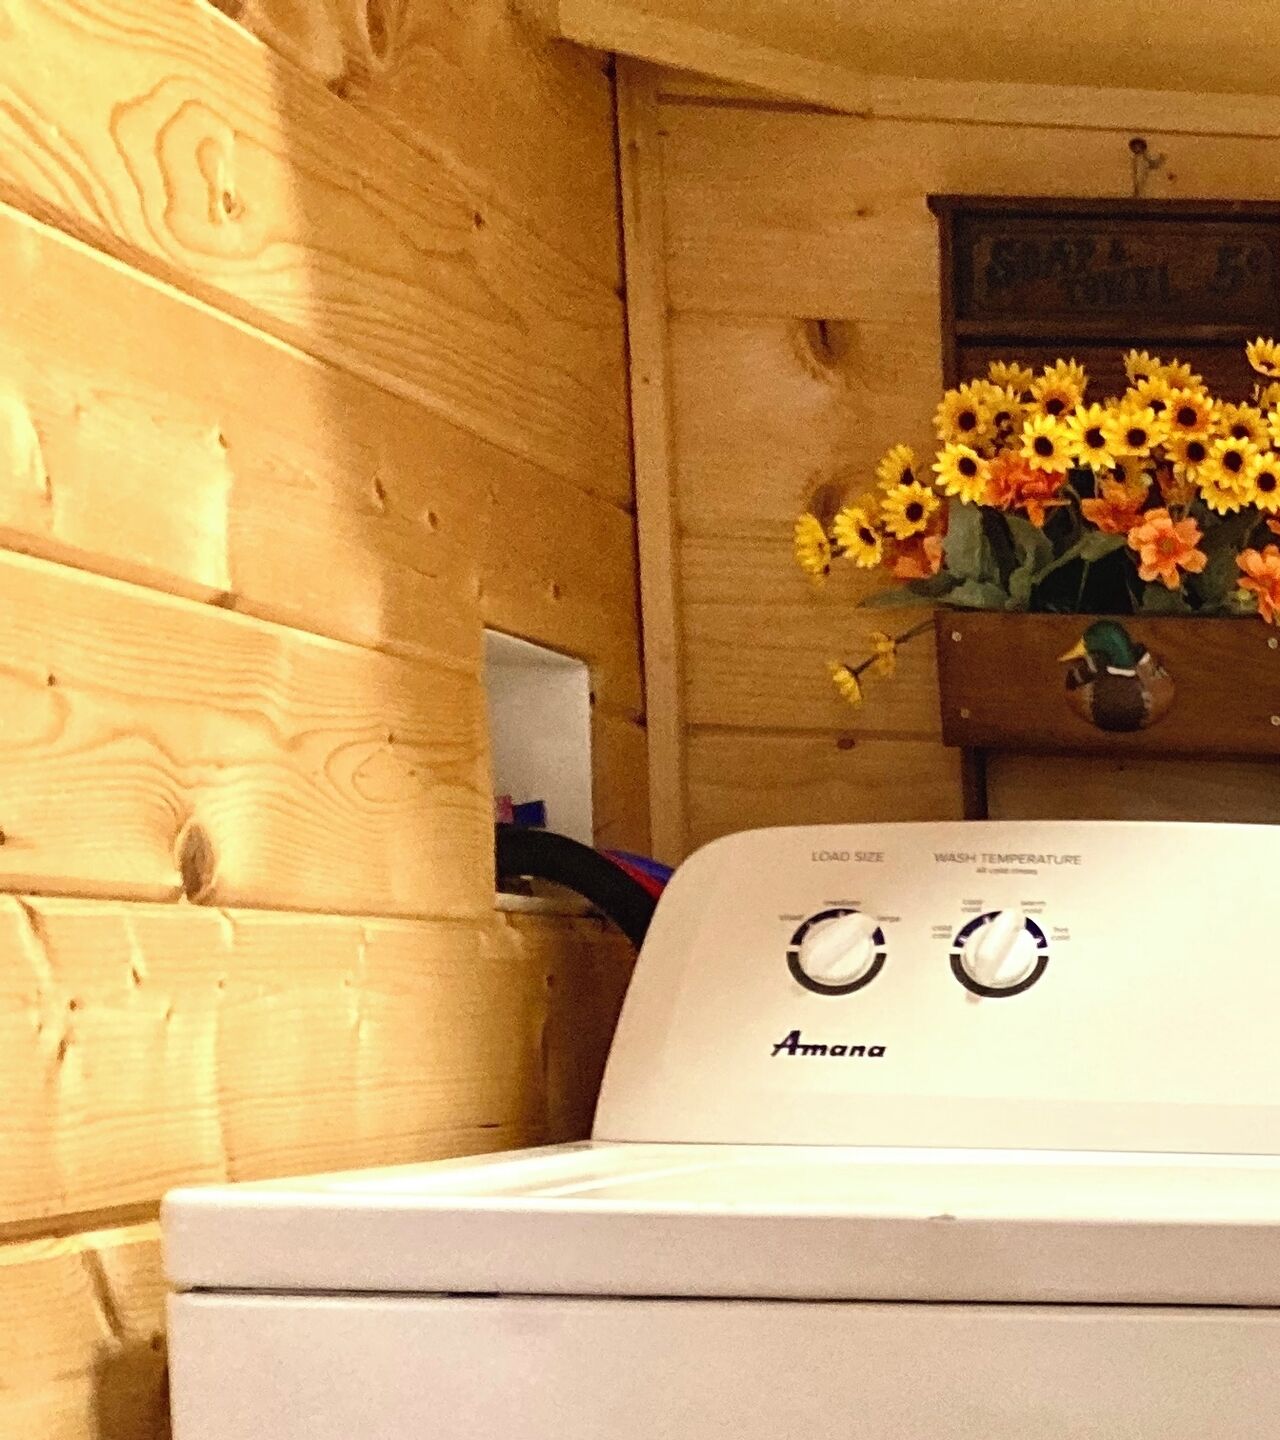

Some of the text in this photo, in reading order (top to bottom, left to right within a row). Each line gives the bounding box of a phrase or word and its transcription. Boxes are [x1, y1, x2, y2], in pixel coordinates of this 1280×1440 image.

[811, 851, 885, 863] LOAD SIZE
[933, 852, 1082, 865] WASH TEMPERATURE
[772, 1030, 887, 1058] Amana
